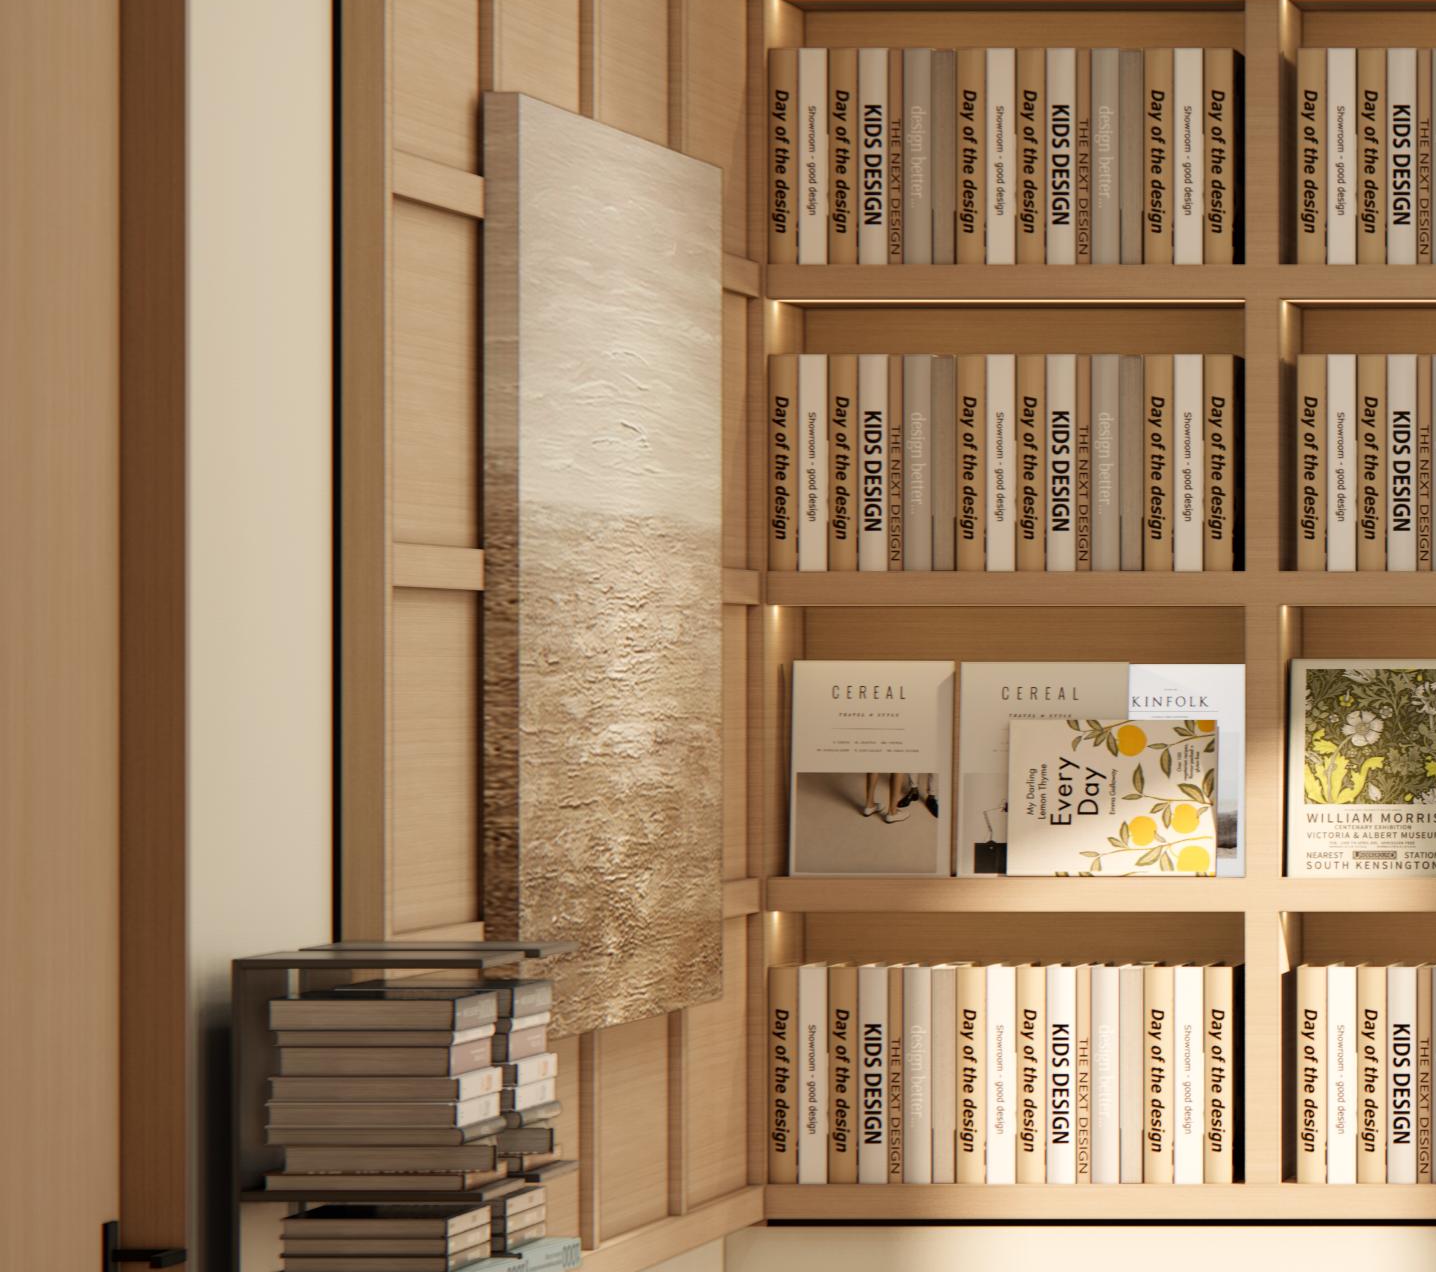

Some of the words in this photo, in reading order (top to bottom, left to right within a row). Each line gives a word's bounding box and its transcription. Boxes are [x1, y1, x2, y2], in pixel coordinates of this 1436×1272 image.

[772, 90, 788, 122] Day
[774, 125, 790, 144] of
[864, 104, 882, 148] KIDS
[1078, 118, 1088, 148] THE
[1336, 106, 1346, 152] Showroom
[774, 148, 790, 174] the
[1078, 153, 1088, 192] NEXT
[1336, 162, 1346, 184] good
[864, 154, 882, 226] DESIGN
[1336, 186, 1346, 216] design
[772, 179, 790, 234] design
[1078, 198, 1088, 254] DESIGN
[960, 396, 976, 428] Day
[962, 431, 978, 451] of
[1052, 411, 1070, 455] KIDS
[1392, 411, 1410, 455] KIDS
[962, 454, 978, 481] the
[1052, 460, 1070, 532] DESIGN
[1392, 460, 1410, 532] DESIGN
[960, 485, 978, 540] design
[832, 685, 906, 700] CEREAL
[1001, 686, 1080, 700] CEREAL
[1132, 696, 1210, 708] KINFOLK
[1026, 768, 1036, 800] Darling
[1038, 764, 1048, 789] Thyme
[1050, 756, 1080, 826] Every
[1077, 767, 1106, 815] Day
[1026, 802, 1036, 815] My
[1038, 790, 1046, 820] Lemon
[1306, 813, 1372, 824] WILLIAM
[1306, 861, 1350, 870] SOUTH
[772, 1009, 790, 1041] Day
[774, 1044, 790, 1064] of
[864, 1024, 882, 1068] KIDS
[774, 1067, 790, 1094] the
[864, 1073, 882, 1145] DESIGN
[772, 1098, 790, 1153] design
